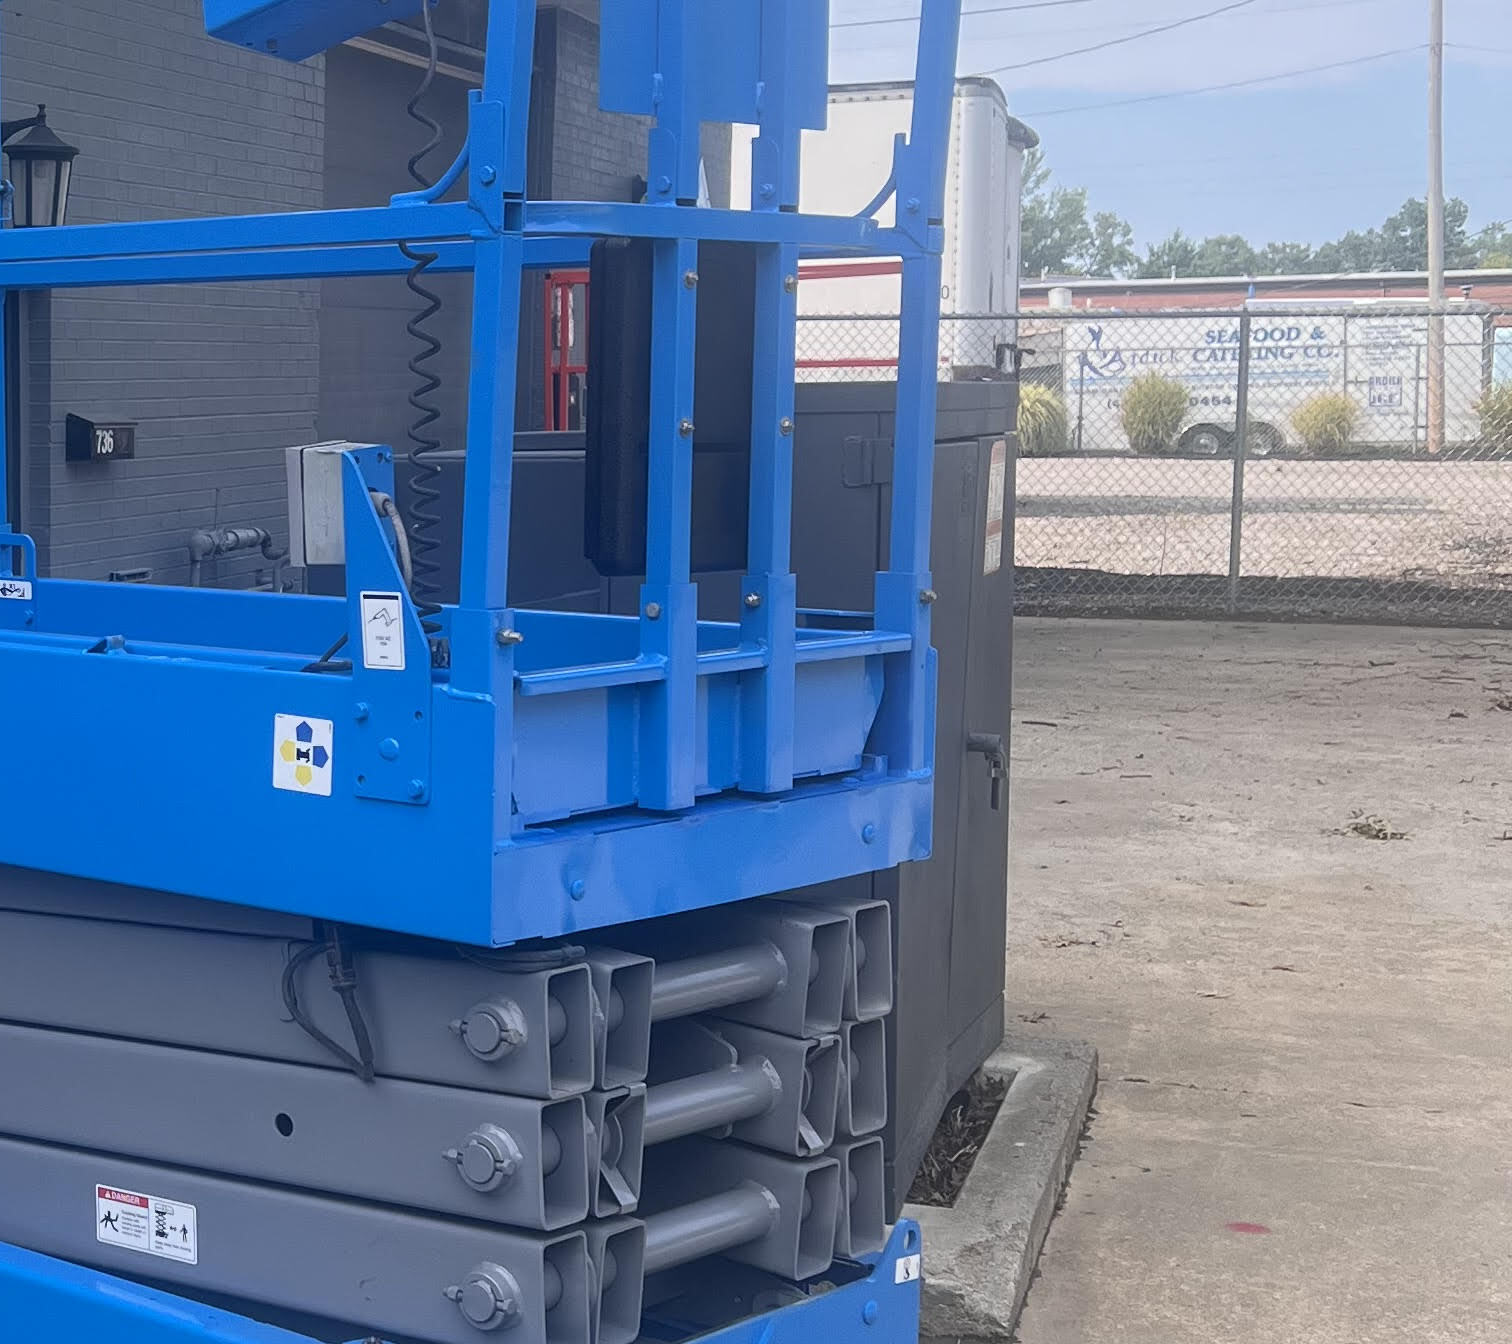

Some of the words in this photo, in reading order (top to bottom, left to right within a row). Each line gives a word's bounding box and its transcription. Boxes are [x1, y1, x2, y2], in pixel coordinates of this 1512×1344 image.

[1205, 327, 1301, 344] SEAOOD
[1310, 326, 1326, 340] &
[96, 430, 114, 454] 736
[111, 1192, 140, 1205] DANGER
